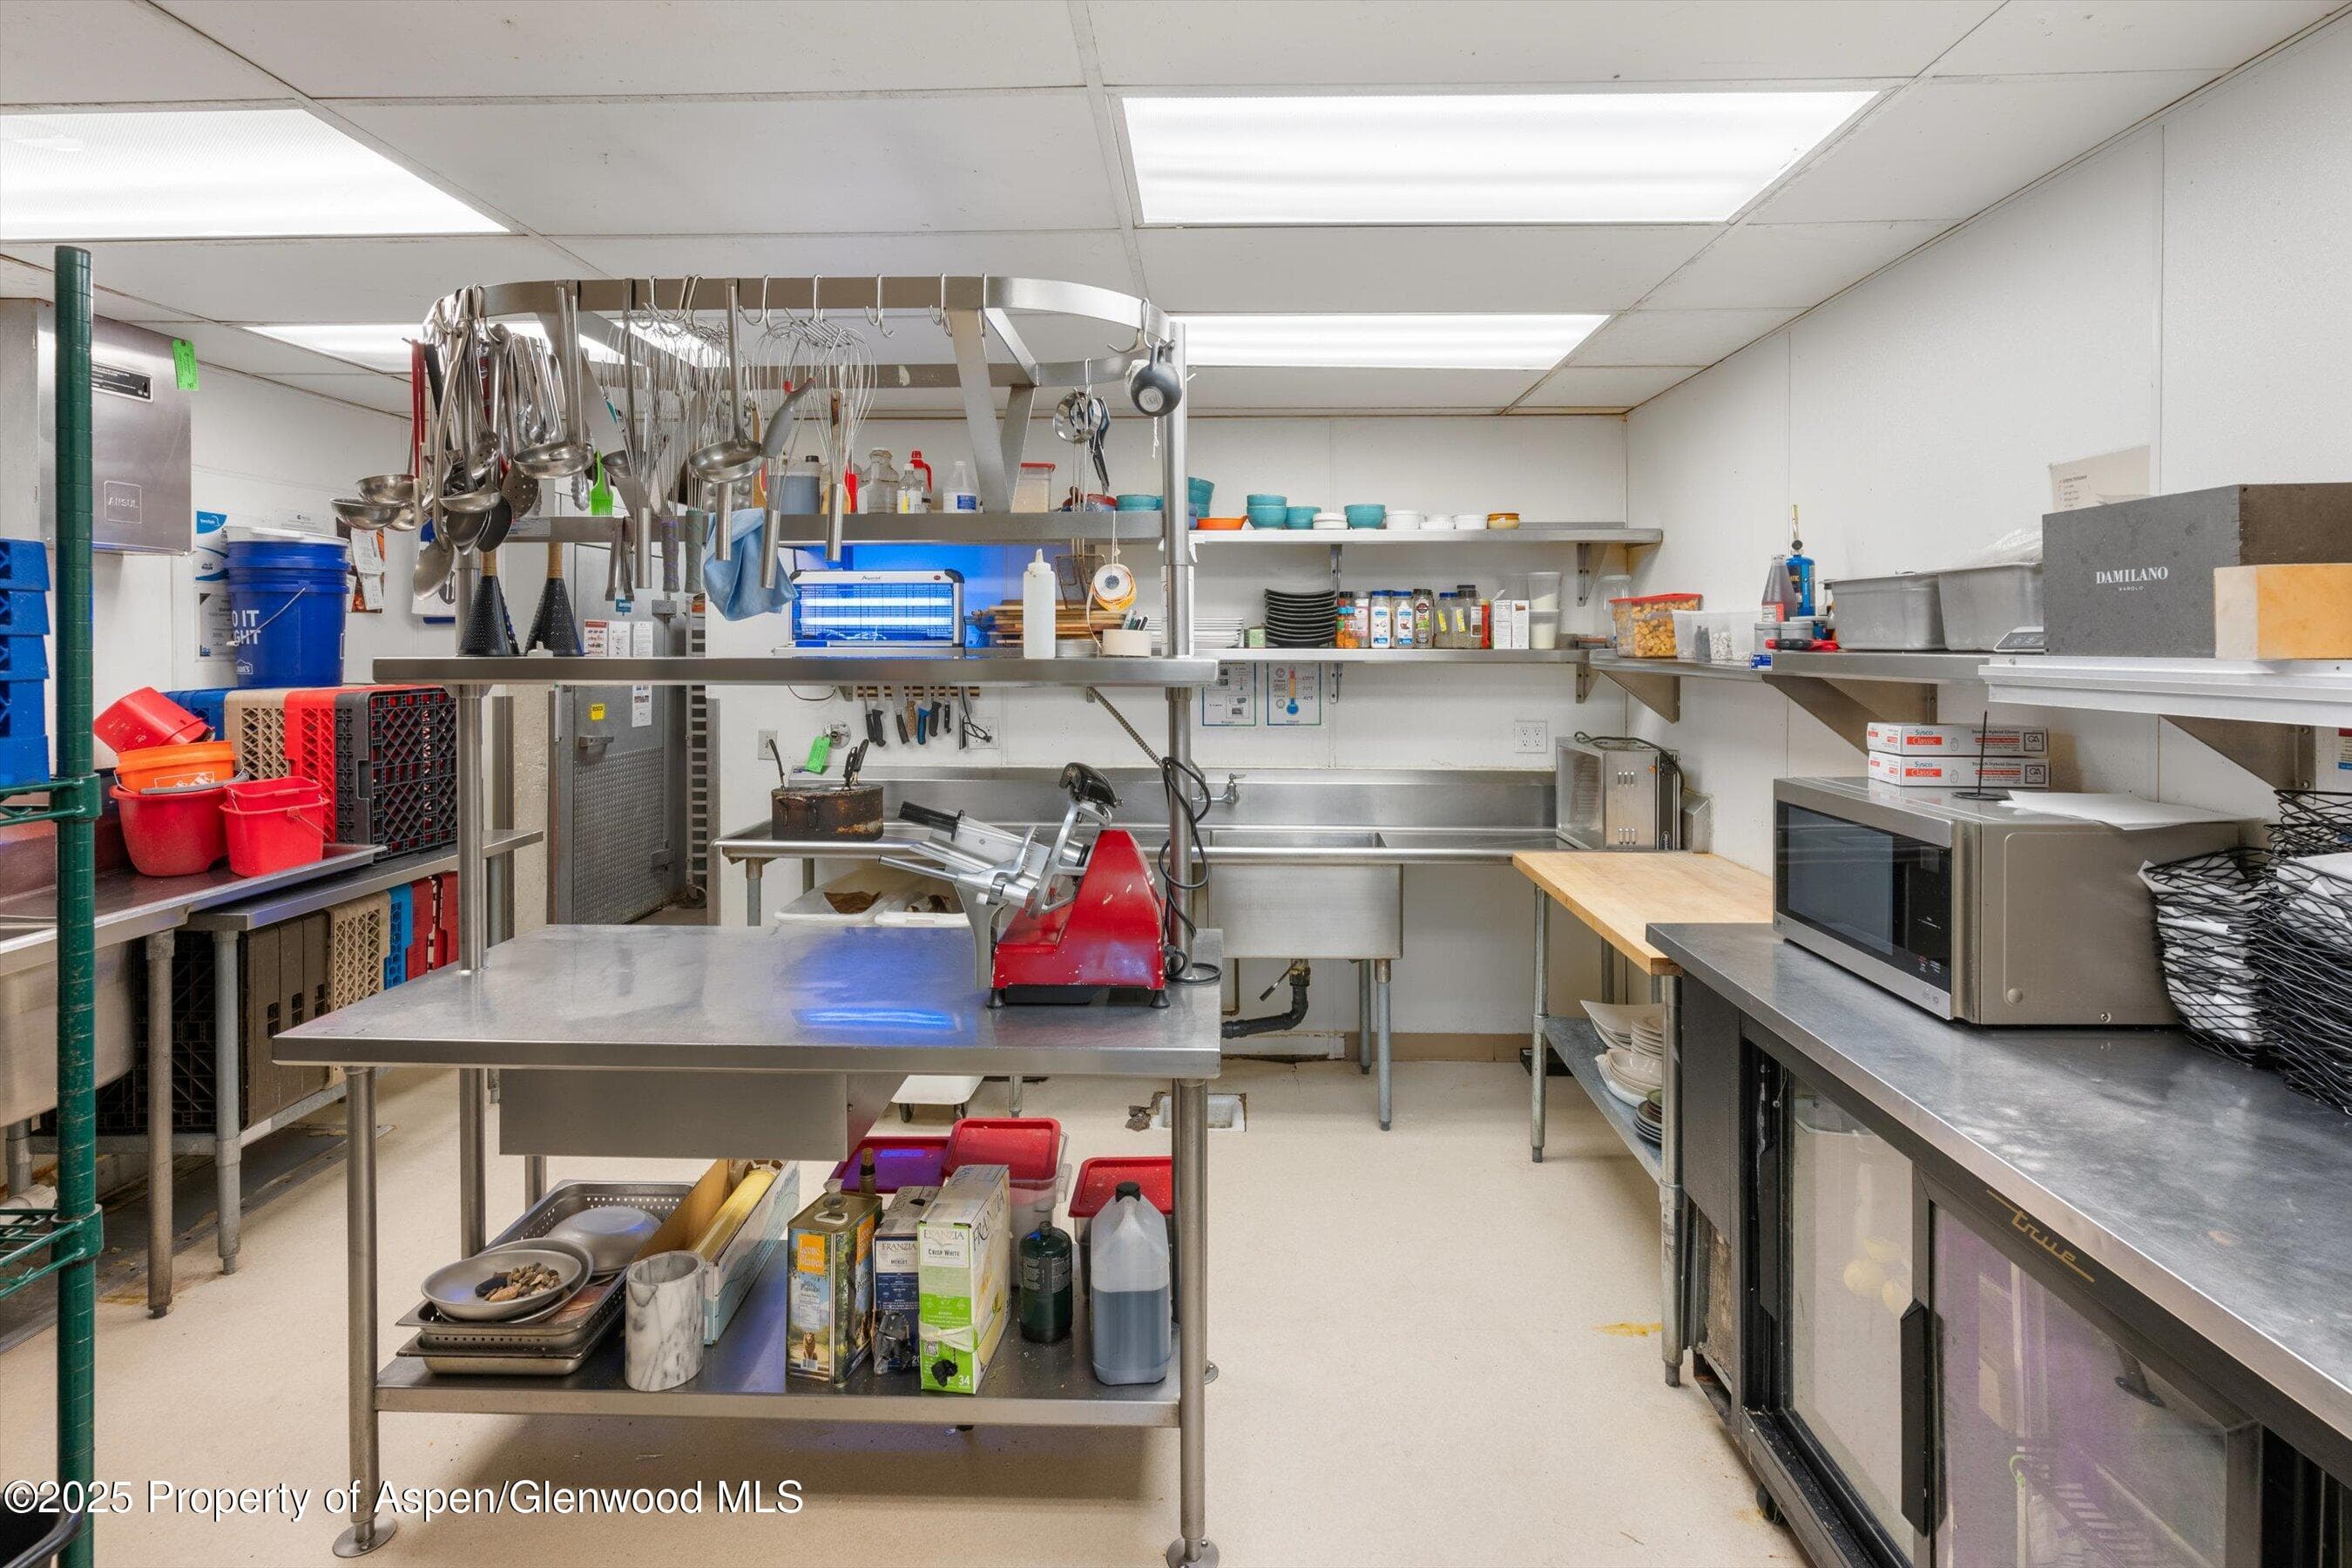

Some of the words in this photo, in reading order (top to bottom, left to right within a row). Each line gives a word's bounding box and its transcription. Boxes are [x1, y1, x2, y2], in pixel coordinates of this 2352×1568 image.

[2096, 566, 2168, 585] DAMILANO
[242, 610, 260, 627] IT
[1910, 768, 1936, 777] Classic
[958, 1375, 970, 1386] 34
